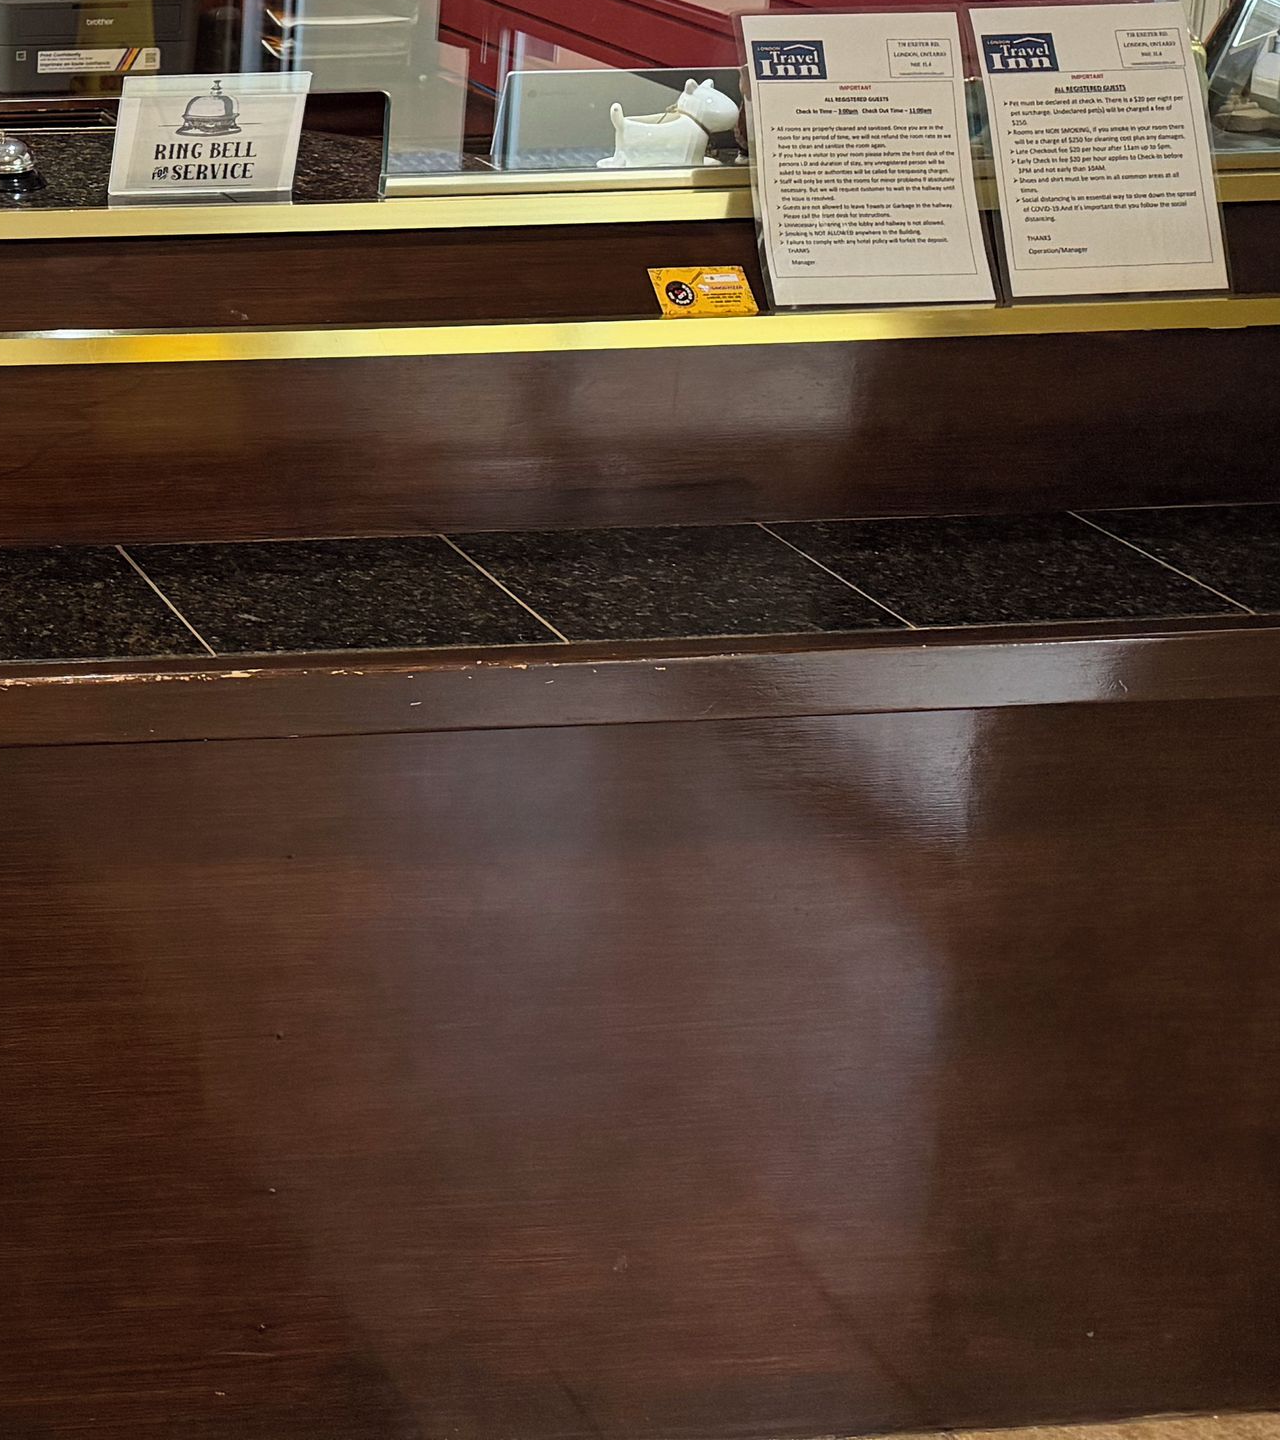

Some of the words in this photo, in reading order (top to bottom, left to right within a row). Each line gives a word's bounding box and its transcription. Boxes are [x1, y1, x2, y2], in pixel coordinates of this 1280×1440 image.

[770, 51, 819, 64] Travel
[1000, 43, 1049, 57] Travel
[760, 60, 821, 76] Inn
[990, 53, 1053, 70] Inn
[154, 142, 202, 160] RING
[210, 141, 257, 159] BELL
[152, 166, 169, 180] FOR
[172, 162, 254, 181] SERVICE
[1028, 247, 1088, 255] Operation/Manager
